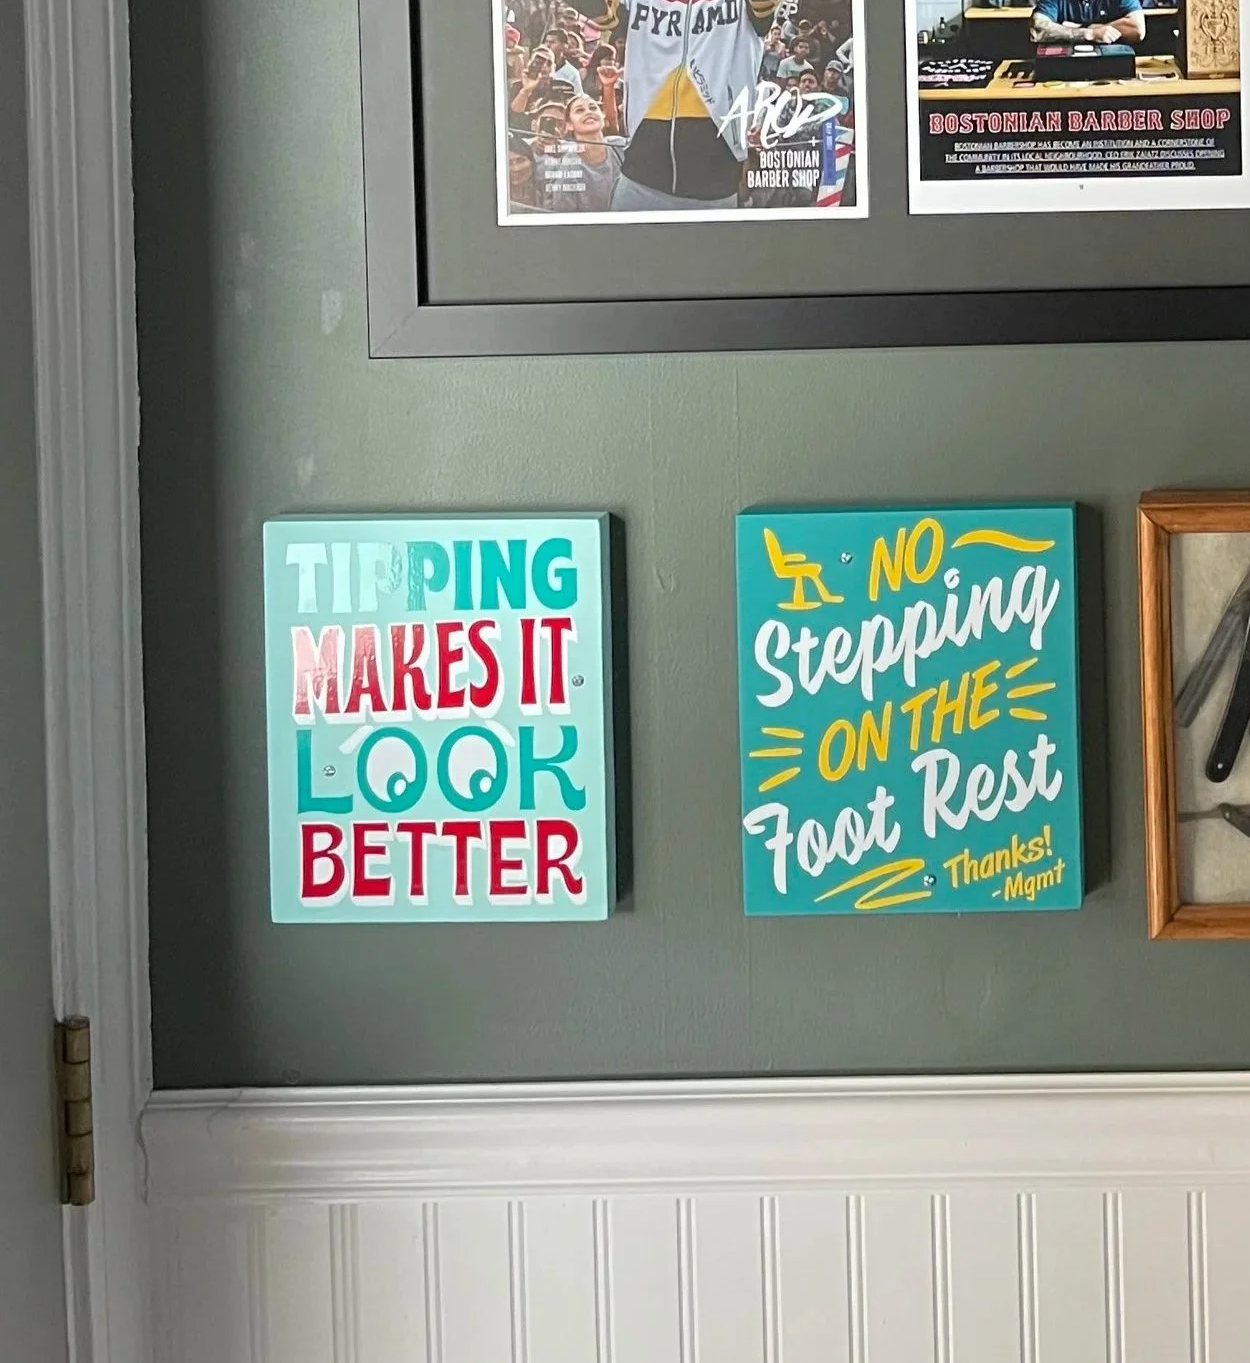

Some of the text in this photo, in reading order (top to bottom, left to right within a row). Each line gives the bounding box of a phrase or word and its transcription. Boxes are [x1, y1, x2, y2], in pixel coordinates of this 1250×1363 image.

[760, 149, 820, 169] BOSTONIAN
[930, 108, 1231, 134] BOSTONIAN BARBER SHOP
[747, 169, 820, 188] BARBER SHOP
[286, 537, 578, 614] TIPPING
[868, 518, 944, 602] NO
[291, 615, 577, 723] MAKES IT
[754, 565, 1060, 708] Stepping
[818, 660, 1001, 782] ON THE
[295, 725, 586, 814] LOOK
[743, 734, 1063, 895] Foot Rest
[943, 824, 1053, 889] Thanks!
[300, 818, 587, 905] BETTER
